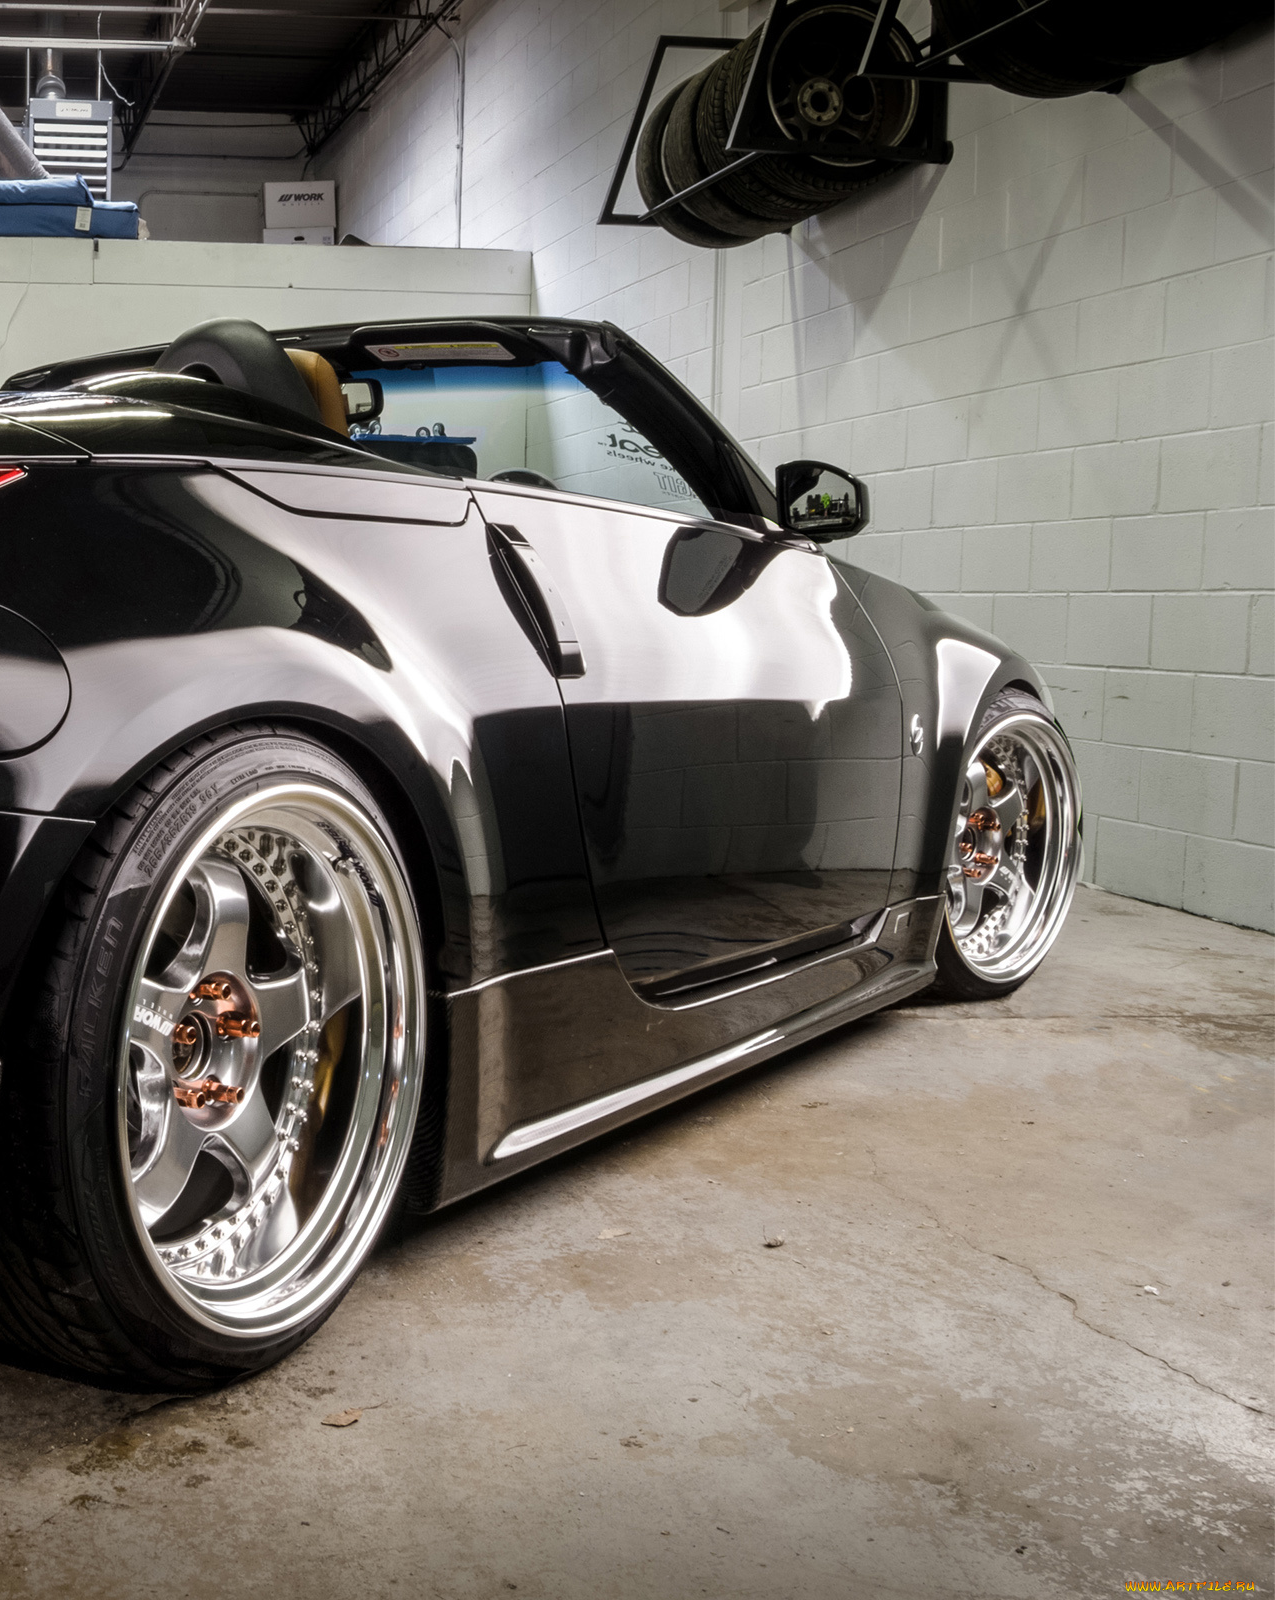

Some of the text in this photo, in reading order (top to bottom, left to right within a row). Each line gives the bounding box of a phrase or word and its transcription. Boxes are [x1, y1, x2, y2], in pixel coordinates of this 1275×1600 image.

[293, 193, 325, 201] WORK
[78, 916, 123, 1098] FALKEN
[133, 1005, 163, 1030] WOR
